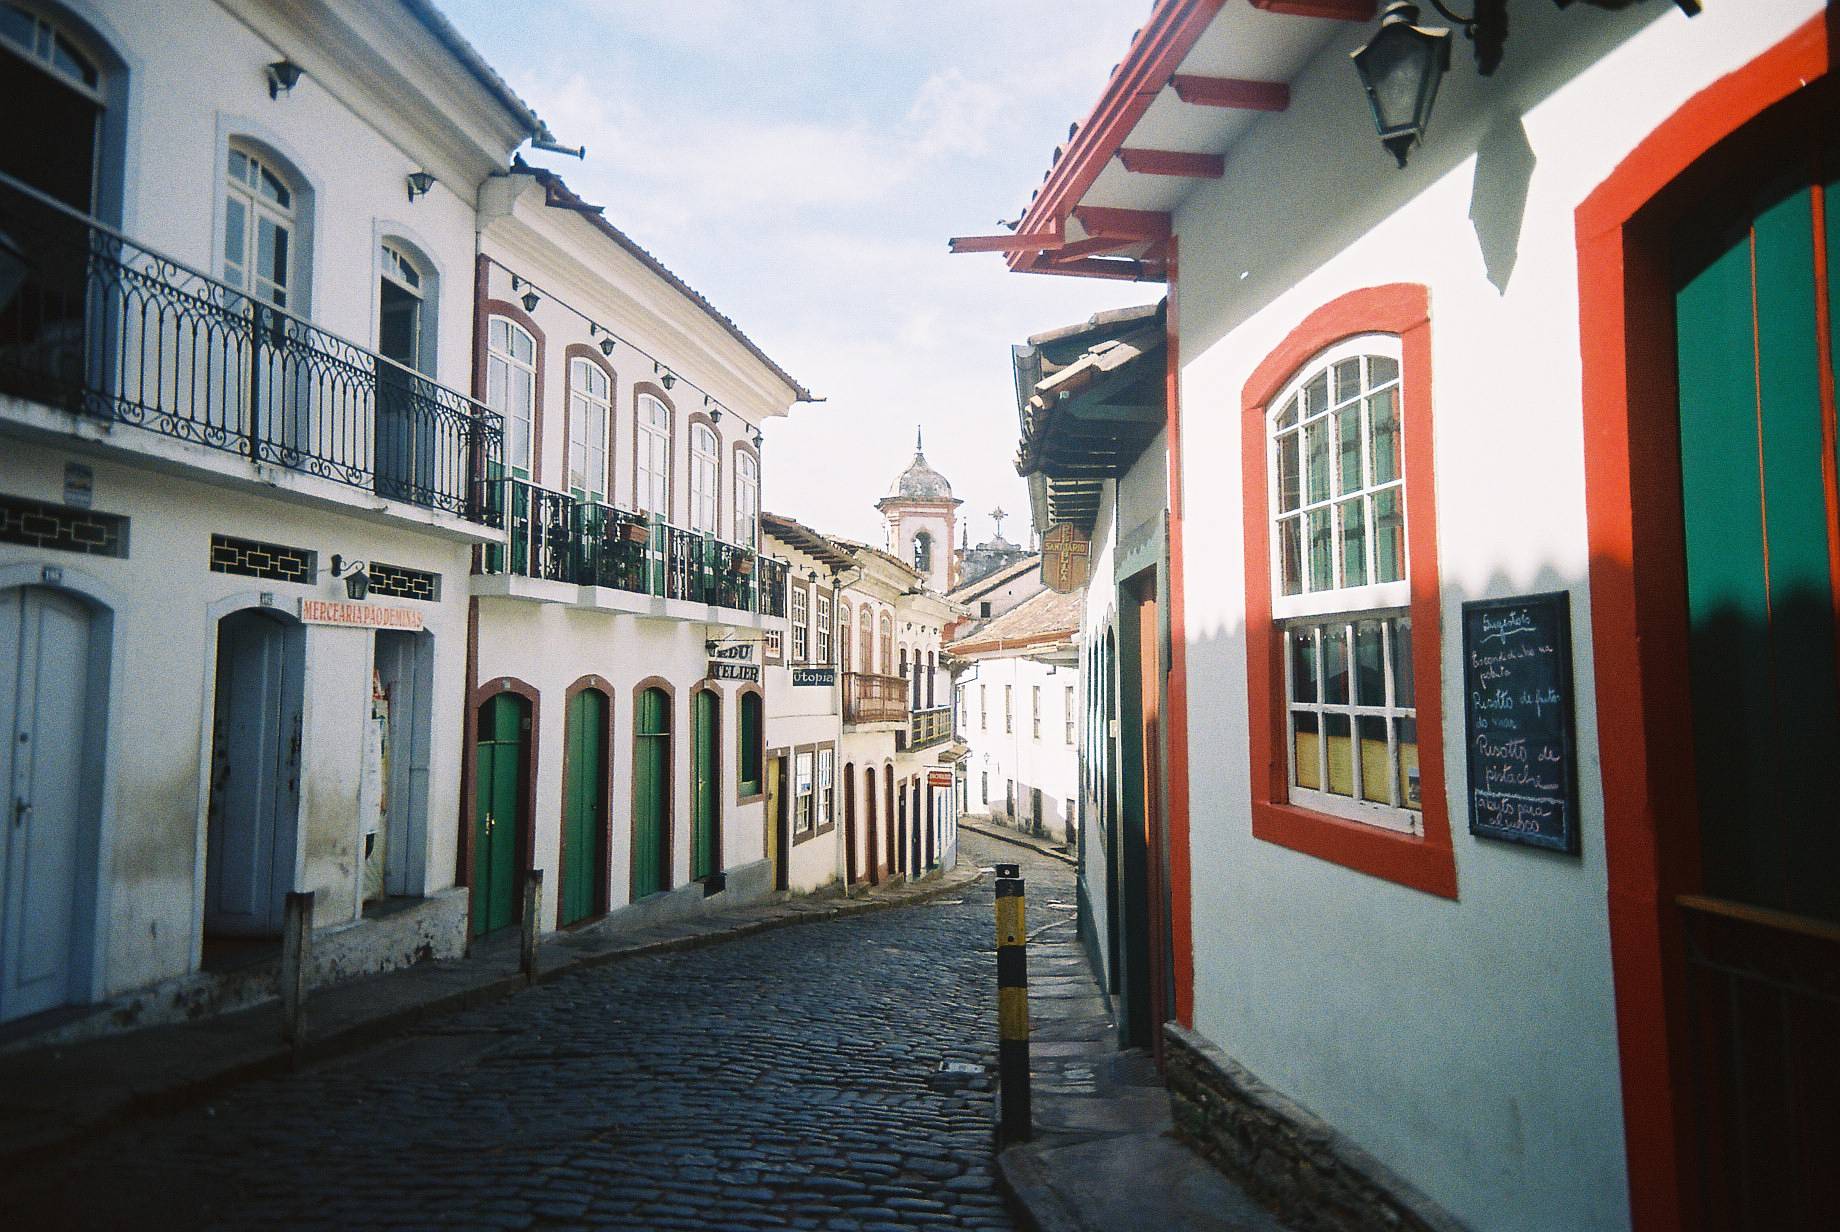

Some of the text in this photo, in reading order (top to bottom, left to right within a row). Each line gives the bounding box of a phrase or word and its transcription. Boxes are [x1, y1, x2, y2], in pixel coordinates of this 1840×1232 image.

[303, 600, 361, 623] MERCEARIA
[1475, 734, 1560, 762] Risotto de
